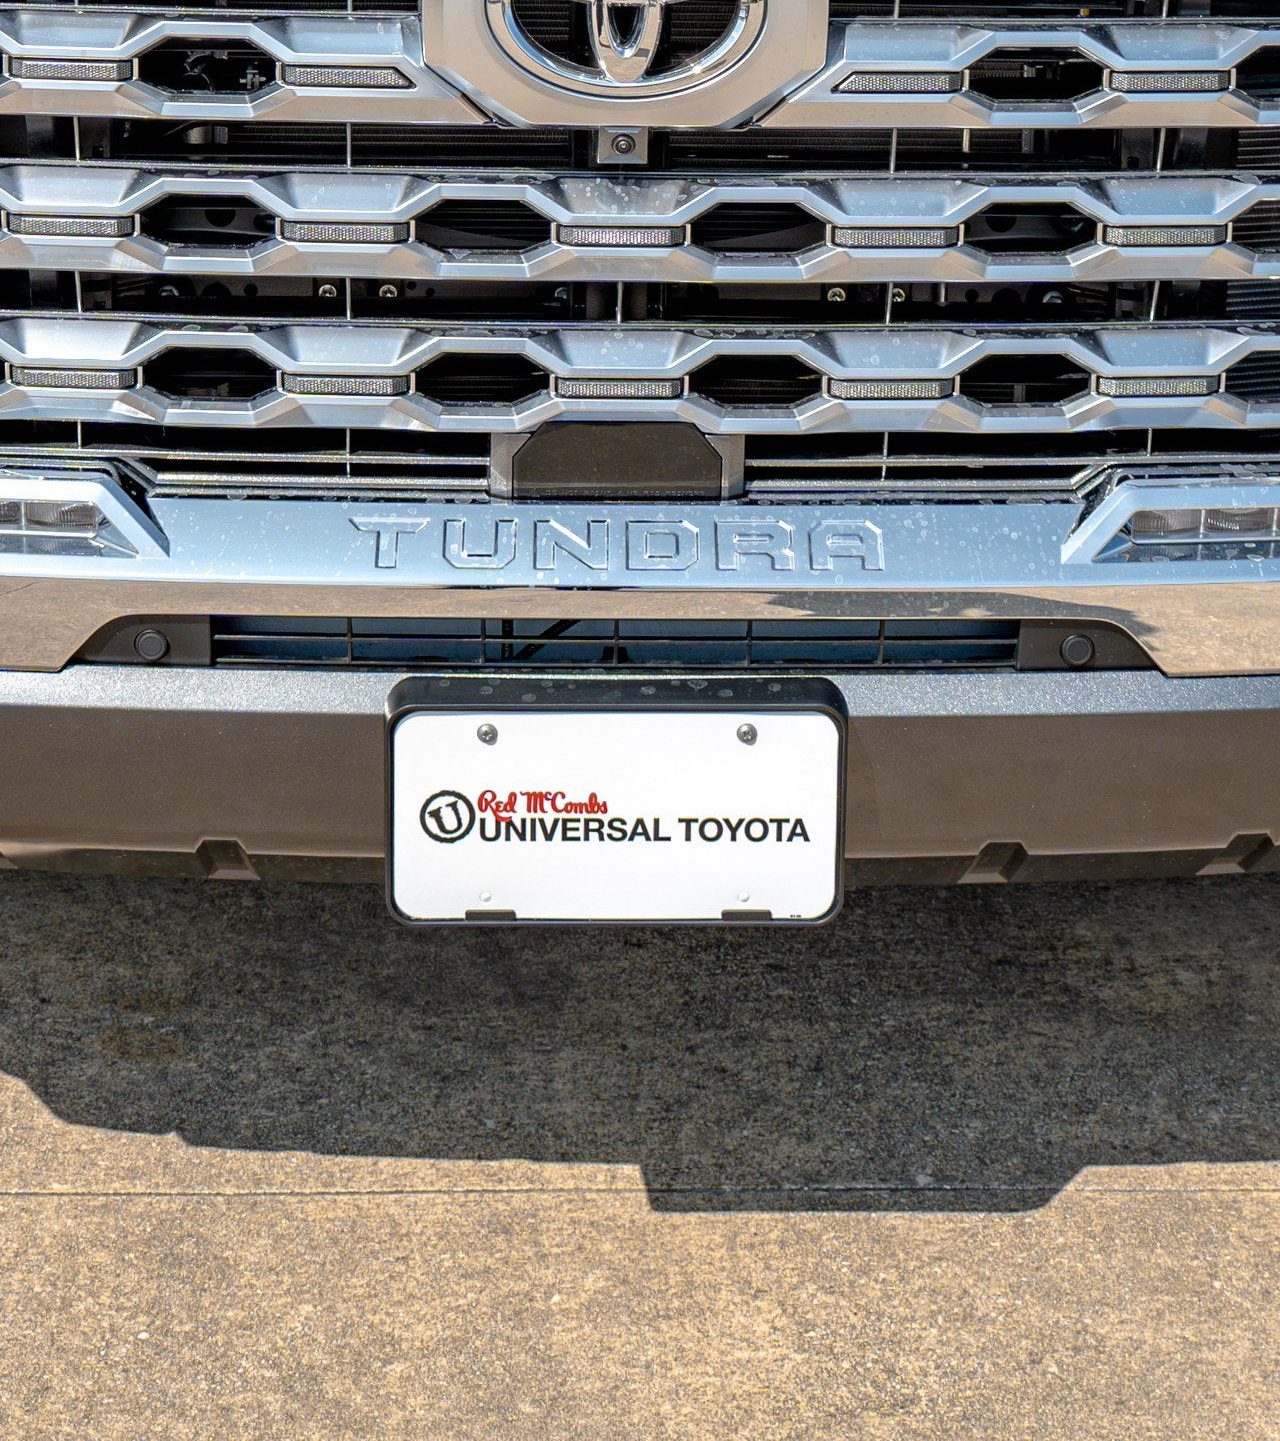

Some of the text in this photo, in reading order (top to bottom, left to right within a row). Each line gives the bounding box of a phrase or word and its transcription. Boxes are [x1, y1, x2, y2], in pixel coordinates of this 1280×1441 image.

[348, 516, 887, 572] TUNDRA
[477, 789, 608, 822] Red McCombs
[479, 817, 811, 843] UNIVERSAL TOYOTA
